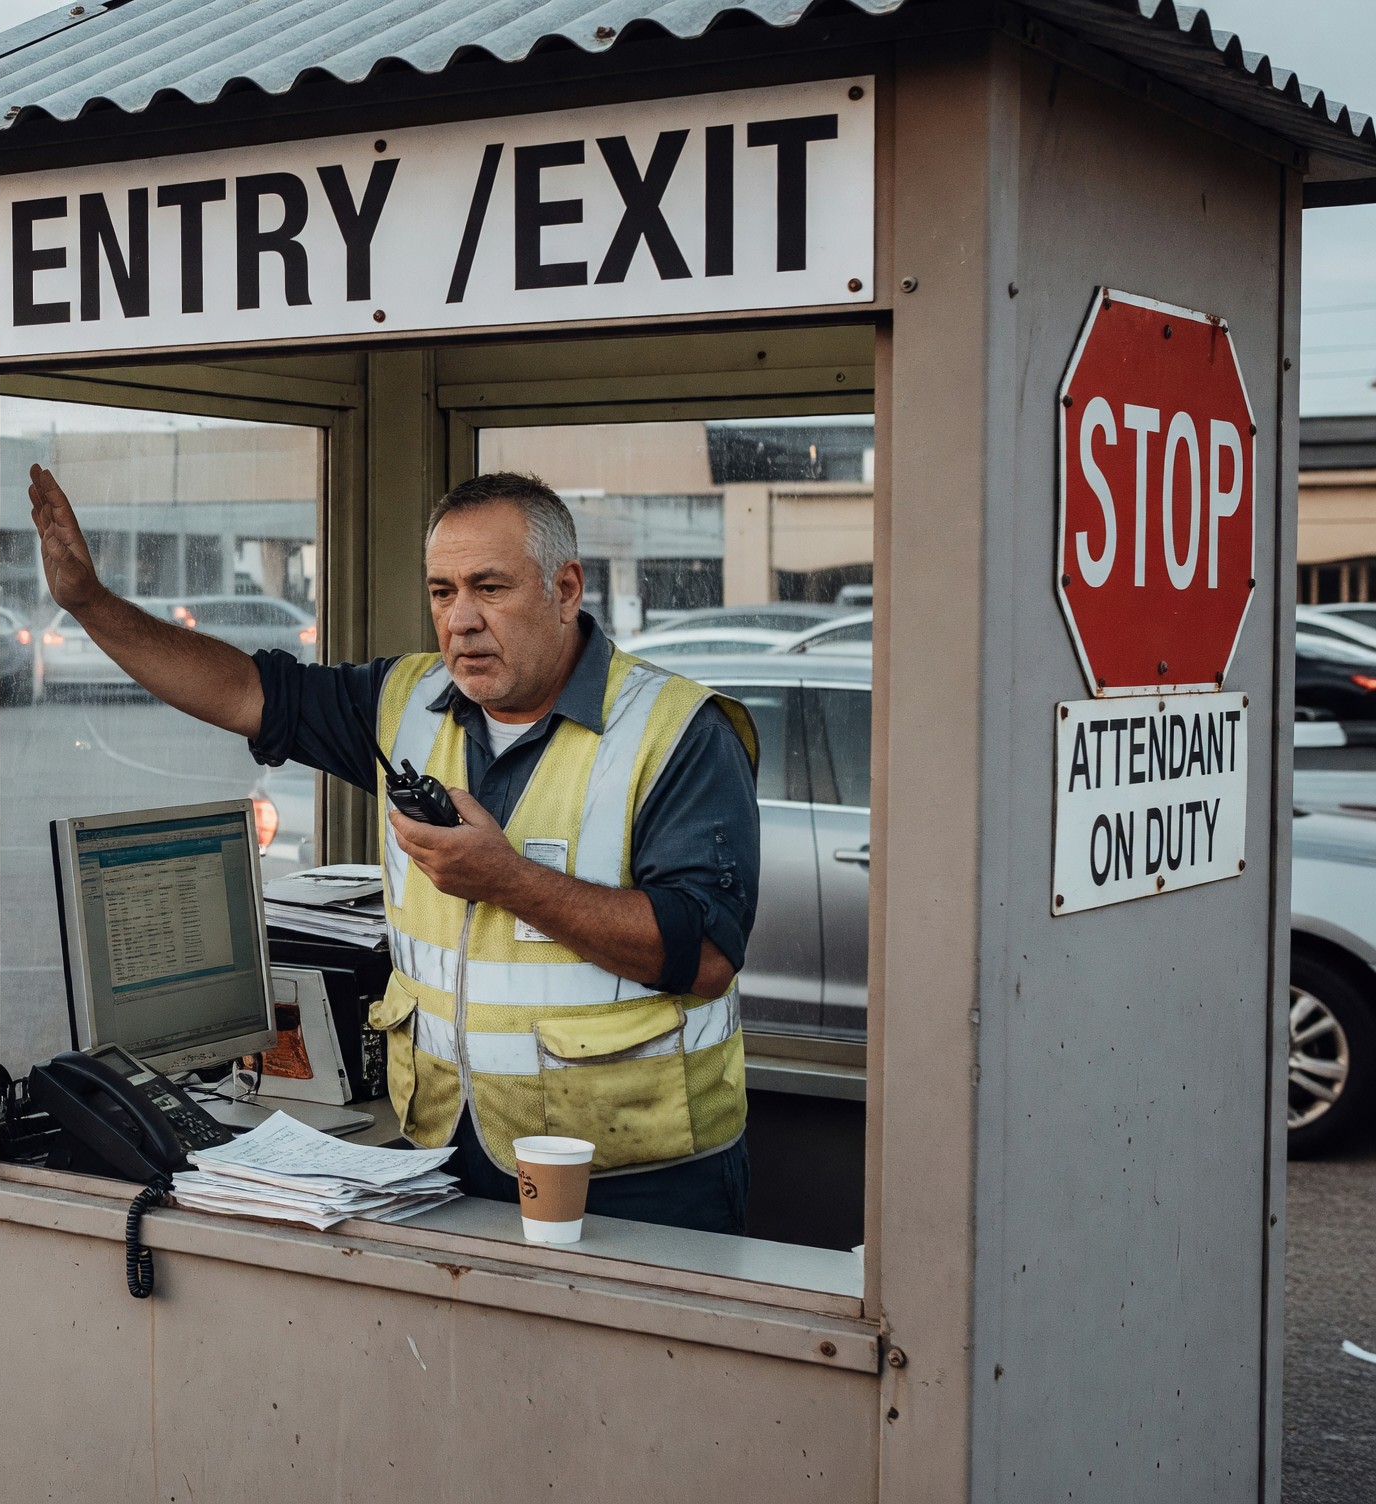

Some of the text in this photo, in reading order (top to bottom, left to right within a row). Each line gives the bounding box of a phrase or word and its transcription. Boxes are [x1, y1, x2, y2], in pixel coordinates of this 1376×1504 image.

[11, 113, 839, 327] ENTRY /EXIT
[1075, 396, 1244, 590] STOP
[1068, 710, 1241, 793] ATTENDANT
[1090, 797, 1221, 887] ON DUTY
